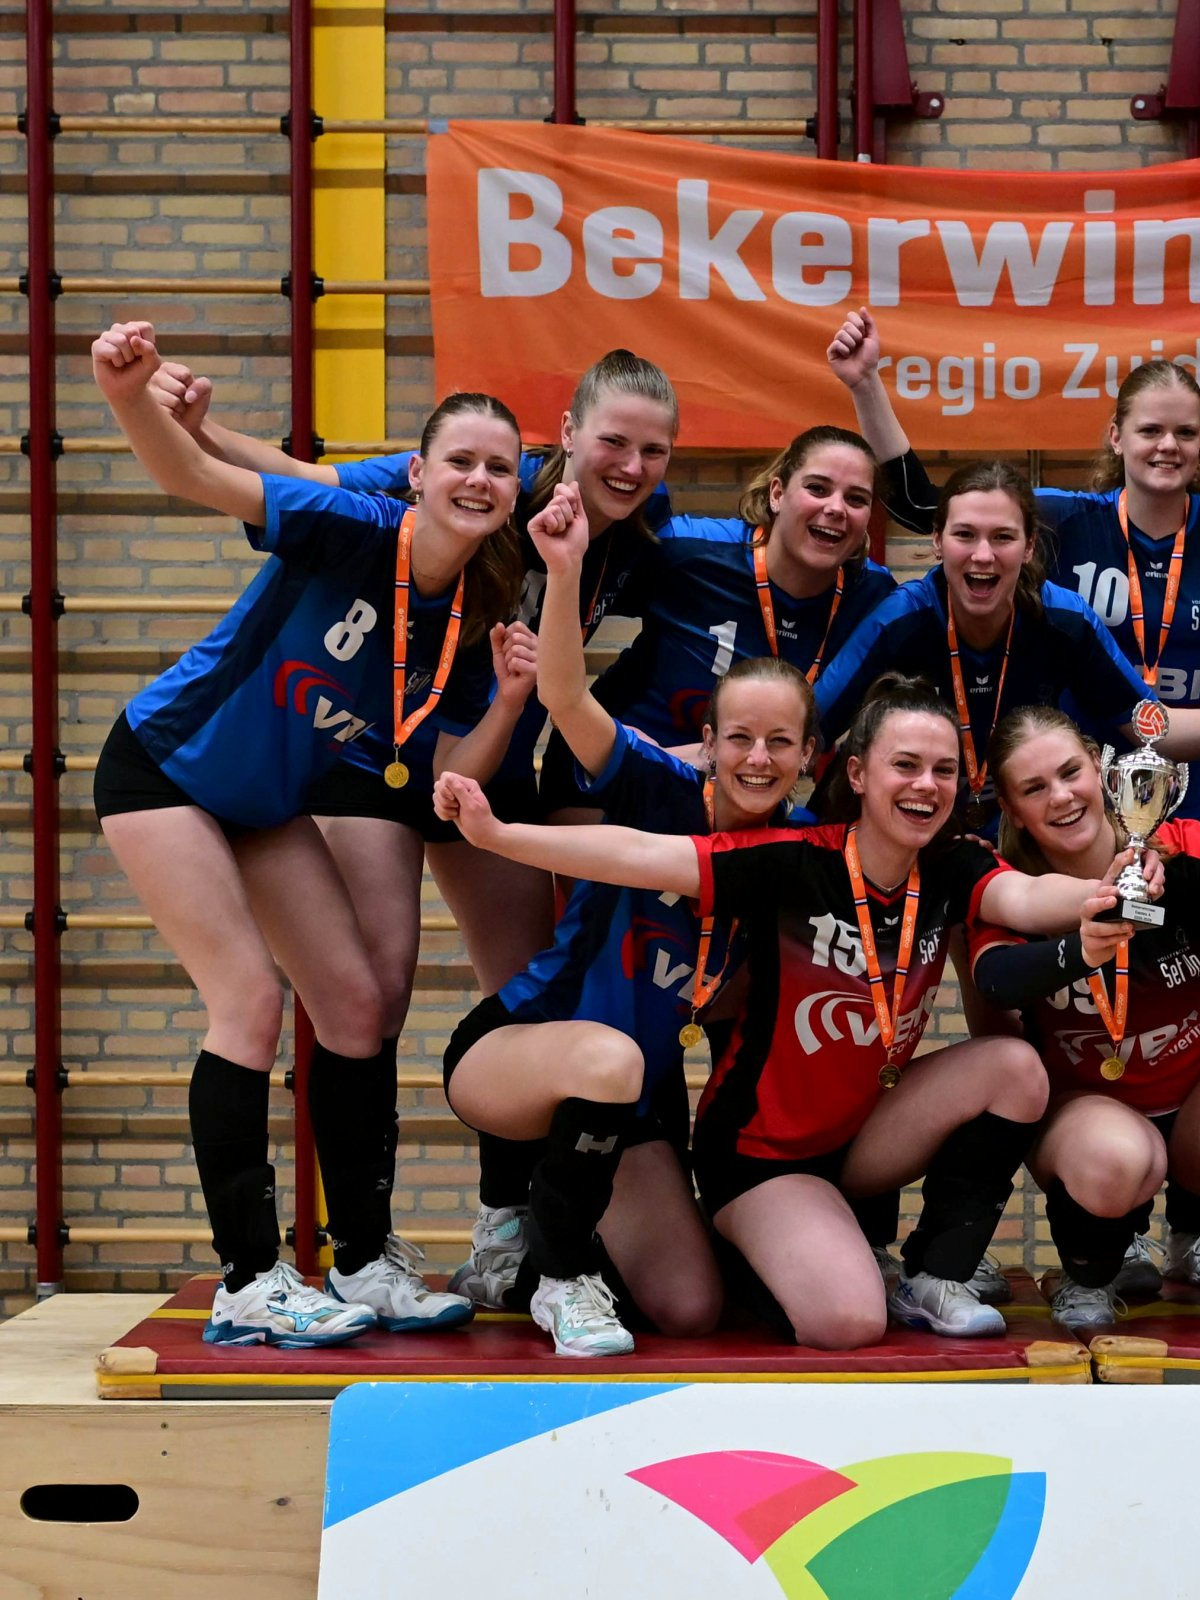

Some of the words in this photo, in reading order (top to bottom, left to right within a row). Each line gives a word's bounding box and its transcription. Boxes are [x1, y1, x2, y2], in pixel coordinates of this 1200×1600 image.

[1072, 561, 1130, 627] 10
[324, 598, 378, 662] 8
[708, 620, 738, 677] 1
[808, 912, 868, 976] 15
[918, 934, 941, 966] Set
[1160, 957, 1187, 988] Set
